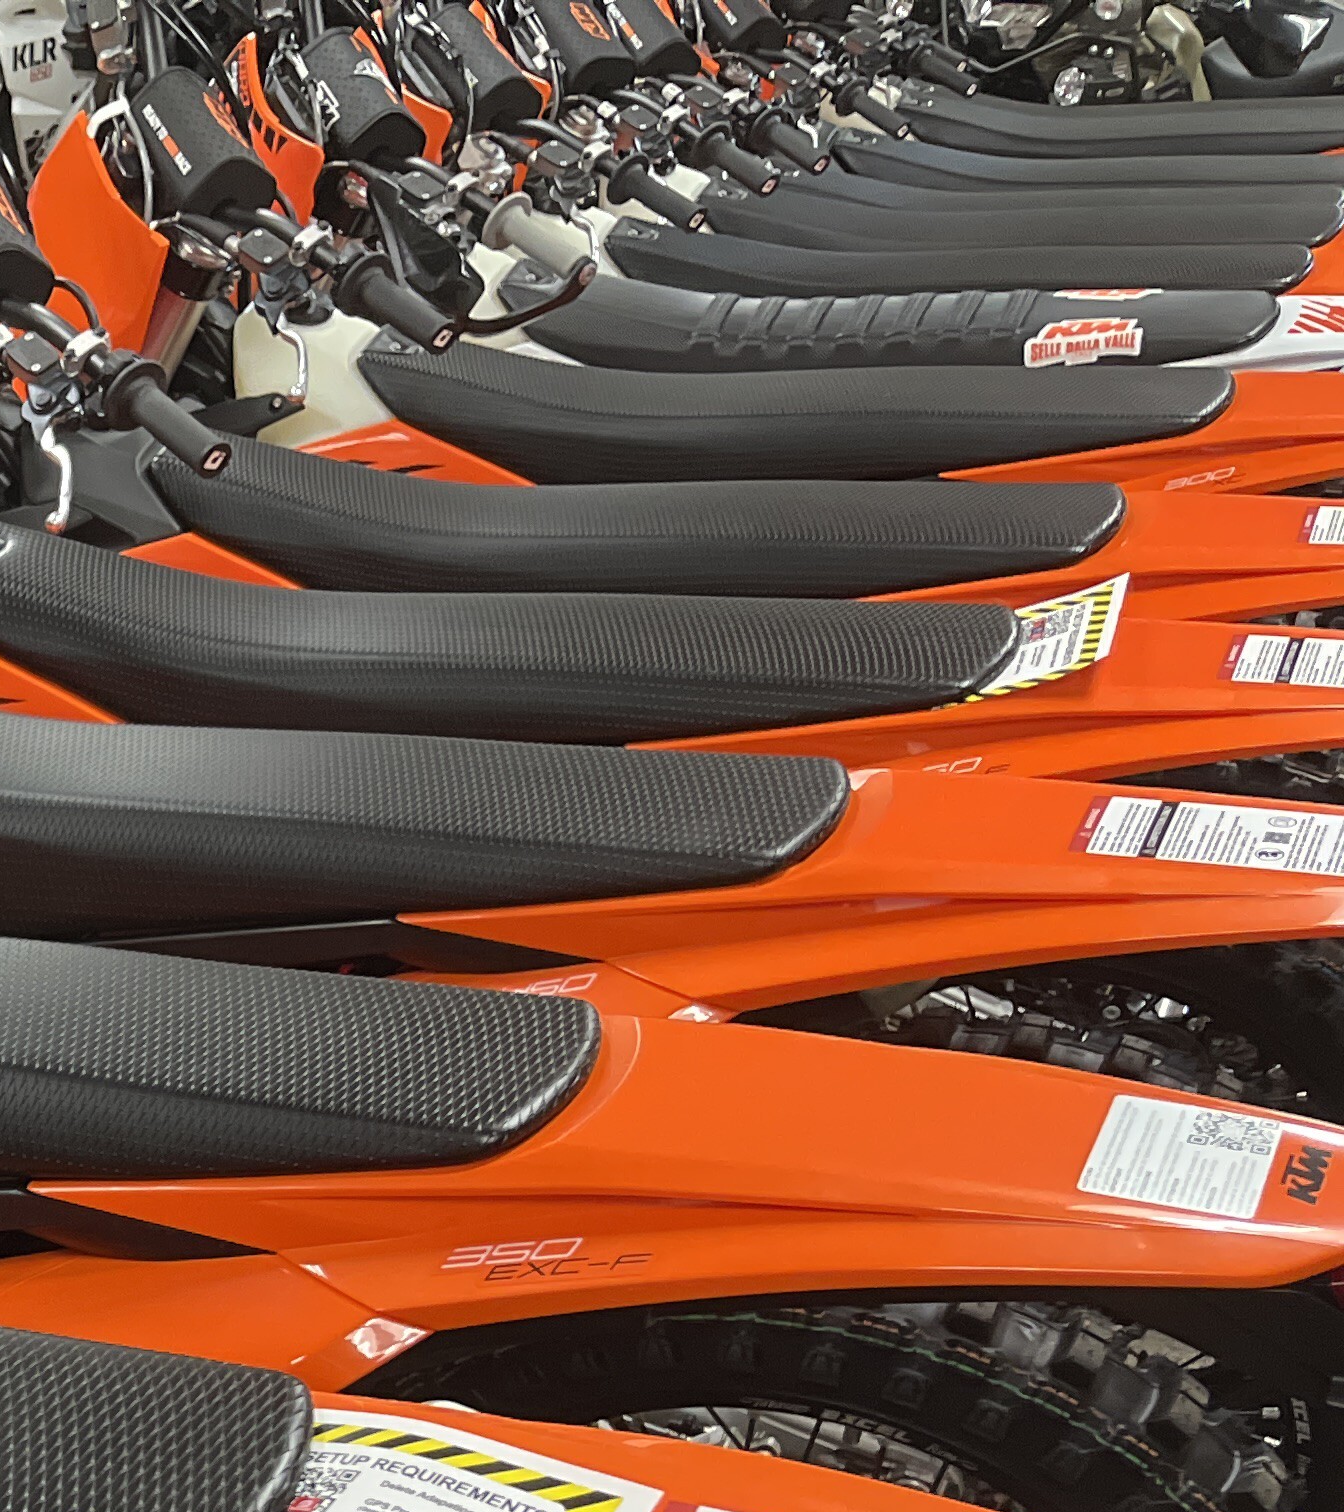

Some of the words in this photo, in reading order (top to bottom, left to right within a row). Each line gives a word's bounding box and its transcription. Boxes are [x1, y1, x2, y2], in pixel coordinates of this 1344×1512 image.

[12, 36, 57, 71] KLR
[1031, 342, 1062, 363] SELLE
[1066, 338, 1100, 353] DALLA
[1104, 332, 1136, 349] VALLE
[1282, 1146, 1334, 1206] KTM
[441, 1237, 583, 1269] 350
[484, 1253, 653, 1281] EXC-F
